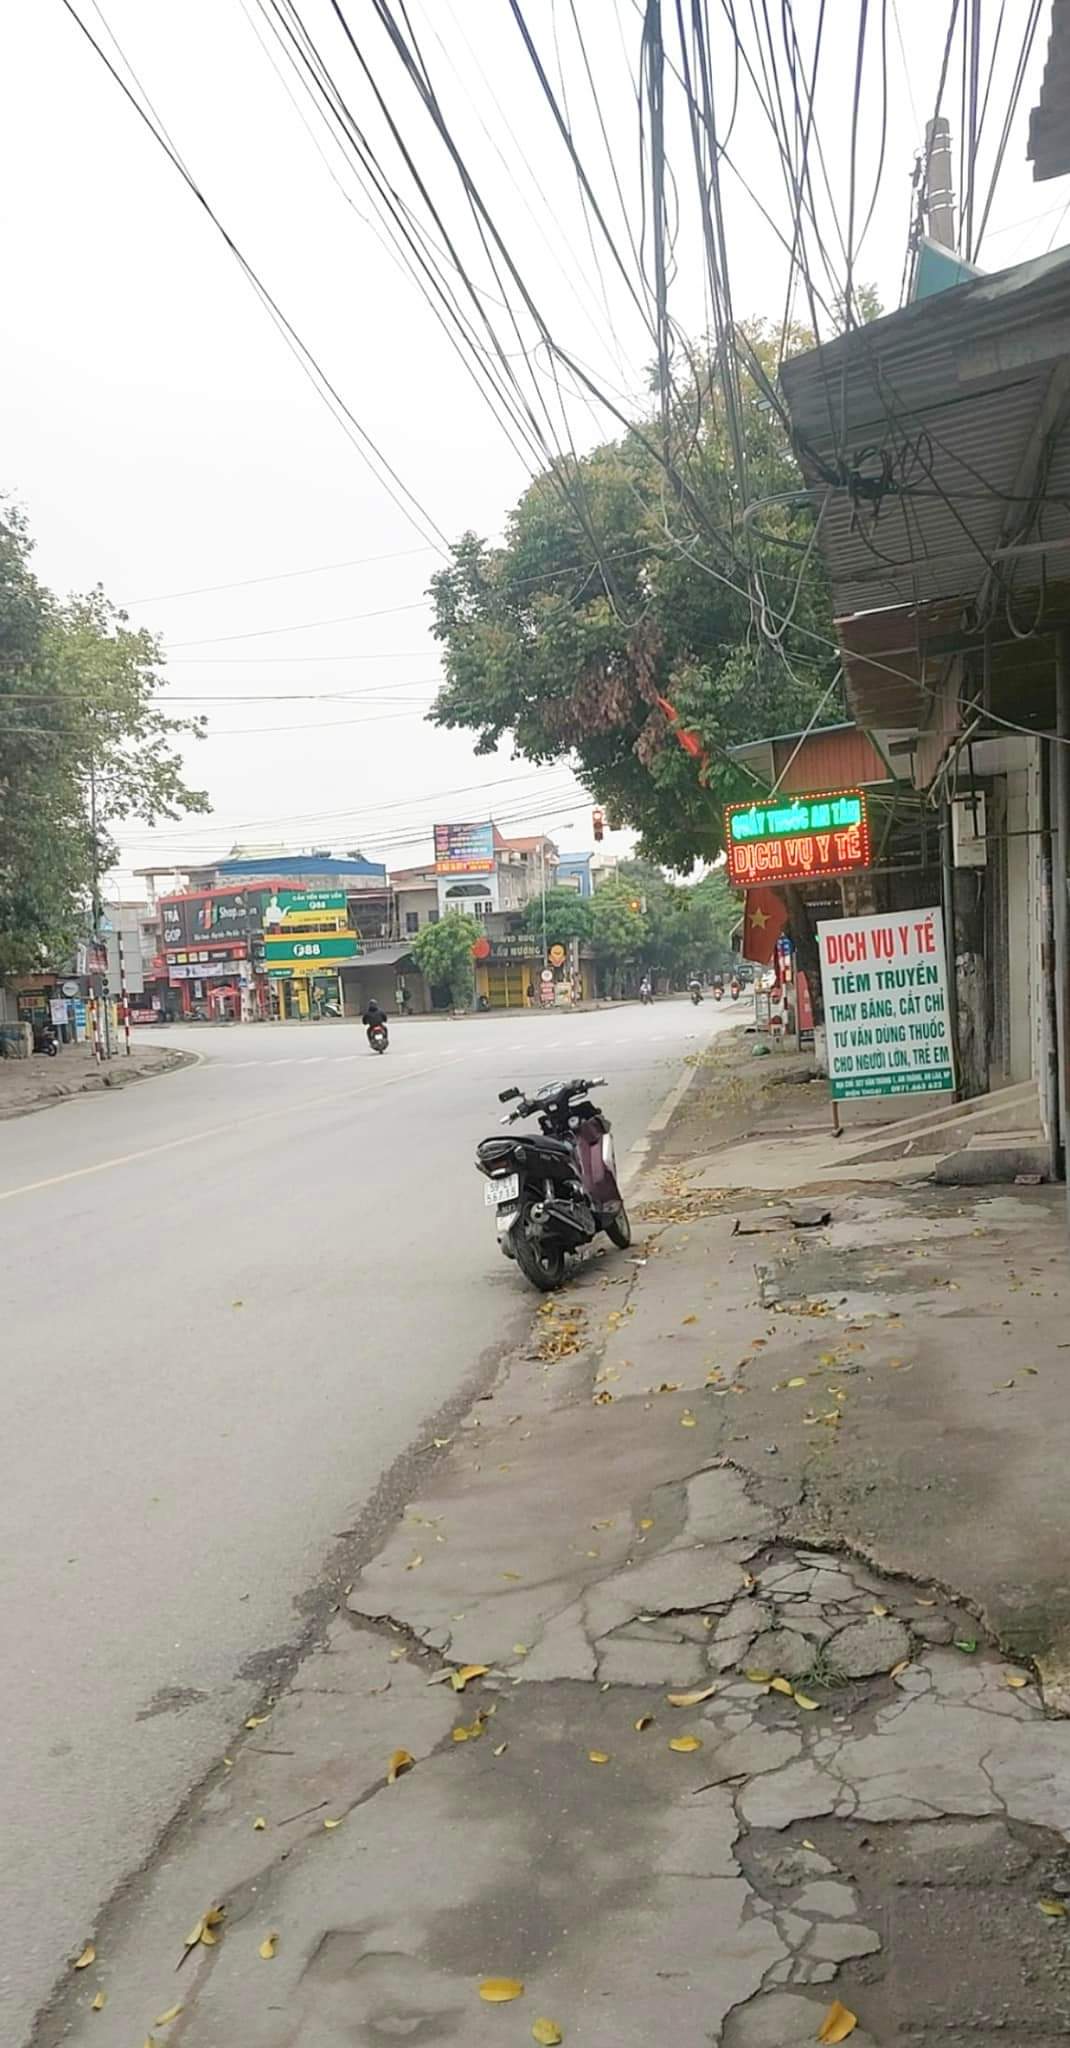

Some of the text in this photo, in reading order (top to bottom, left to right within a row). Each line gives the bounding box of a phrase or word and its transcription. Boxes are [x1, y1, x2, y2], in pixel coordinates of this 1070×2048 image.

[734, 821, 861, 877] DỊCH VỤ Y TẾ
[163, 905, 180, 922] TRẢ
[826, 912, 936, 969] DỊCH VỤ Y TẾ
[832, 971, 871, 995] TIÊM
[830, 1003, 857, 1022] THAY
[860, 998, 896, 1019] BĂNG,
[924, 987, 945, 1013] CHỈ
[834, 1016, 945, 1048] TƯ VẤN DÙNG THUỐC
[833, 1056, 854, 1073] CHO
[856, 1048, 886, 1071] NGƯỜI
[933, 1045, 950, 1063] EM
